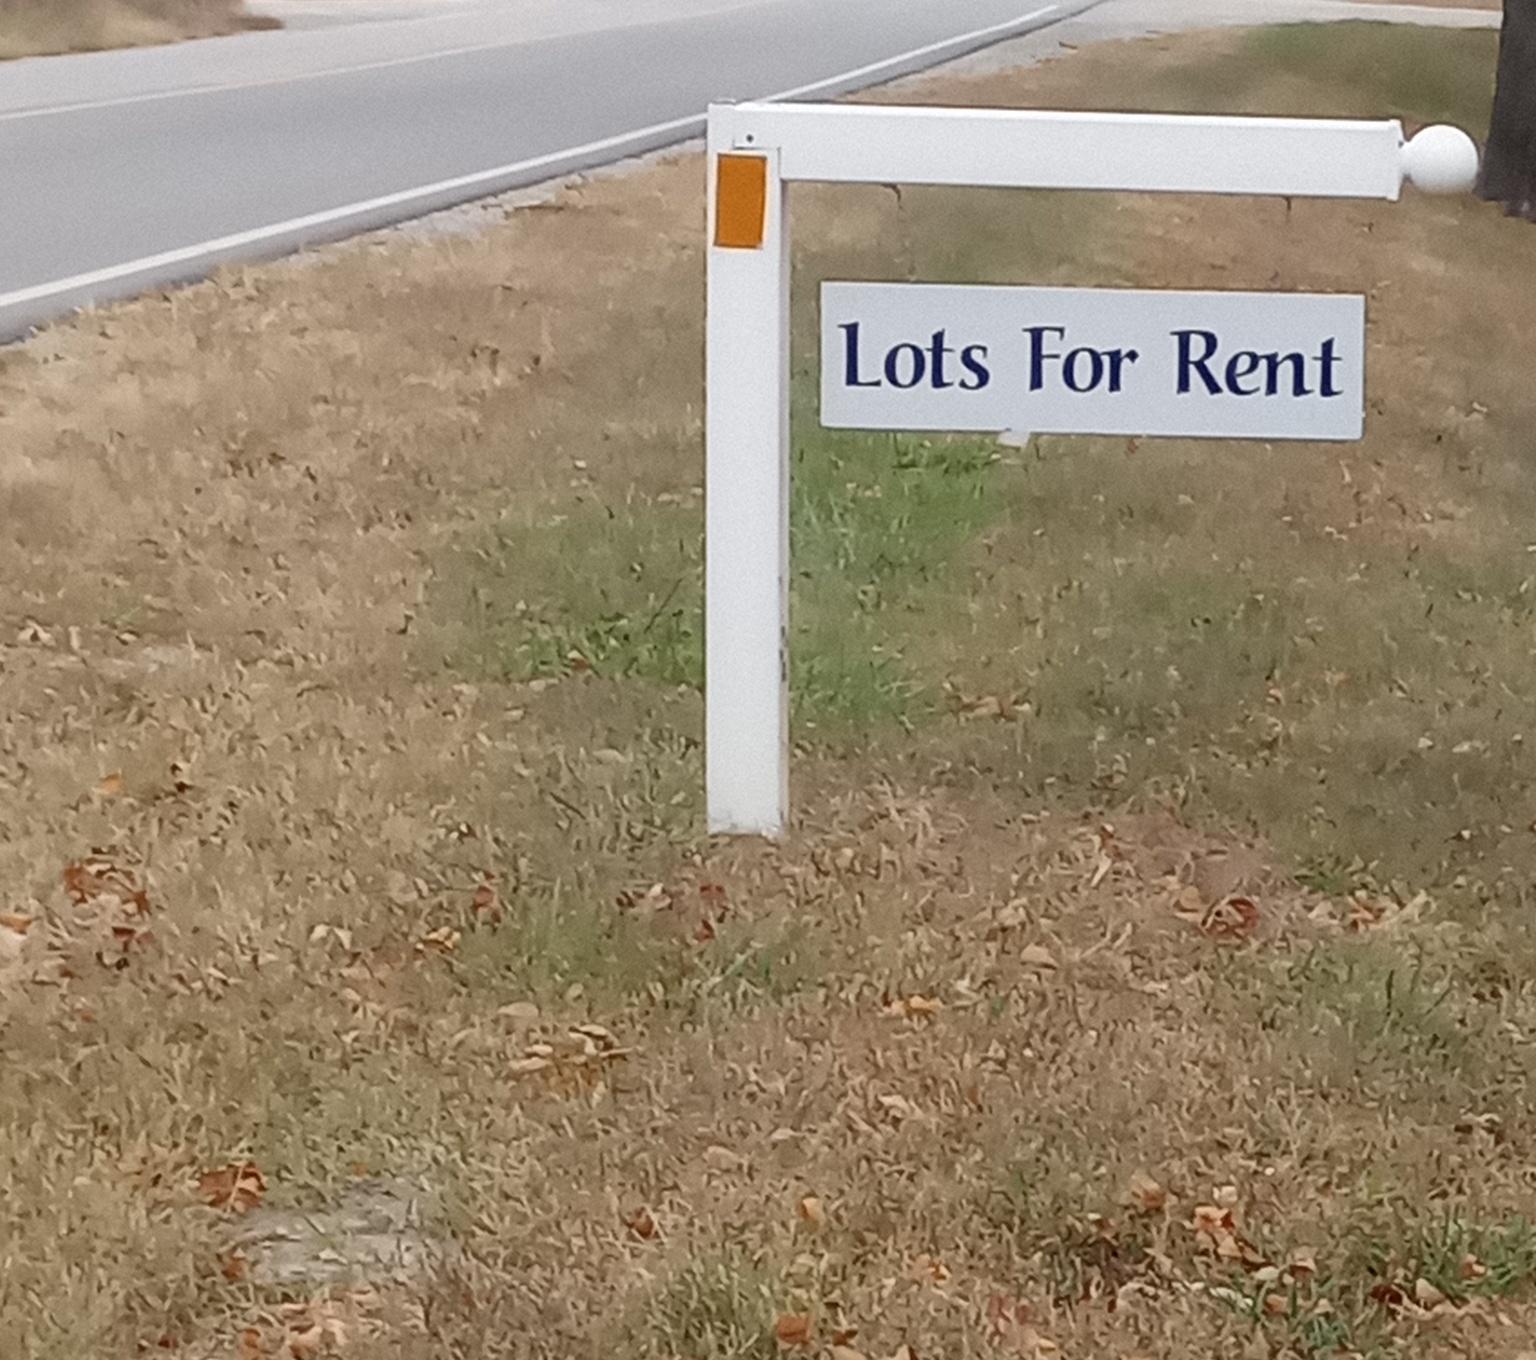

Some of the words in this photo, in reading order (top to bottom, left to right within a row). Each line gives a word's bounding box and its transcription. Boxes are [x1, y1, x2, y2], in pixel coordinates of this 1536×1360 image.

[837, 321, 990, 391] Lots
[1022, 326, 1140, 393] For
[1169, 329, 1343, 398] Rent
